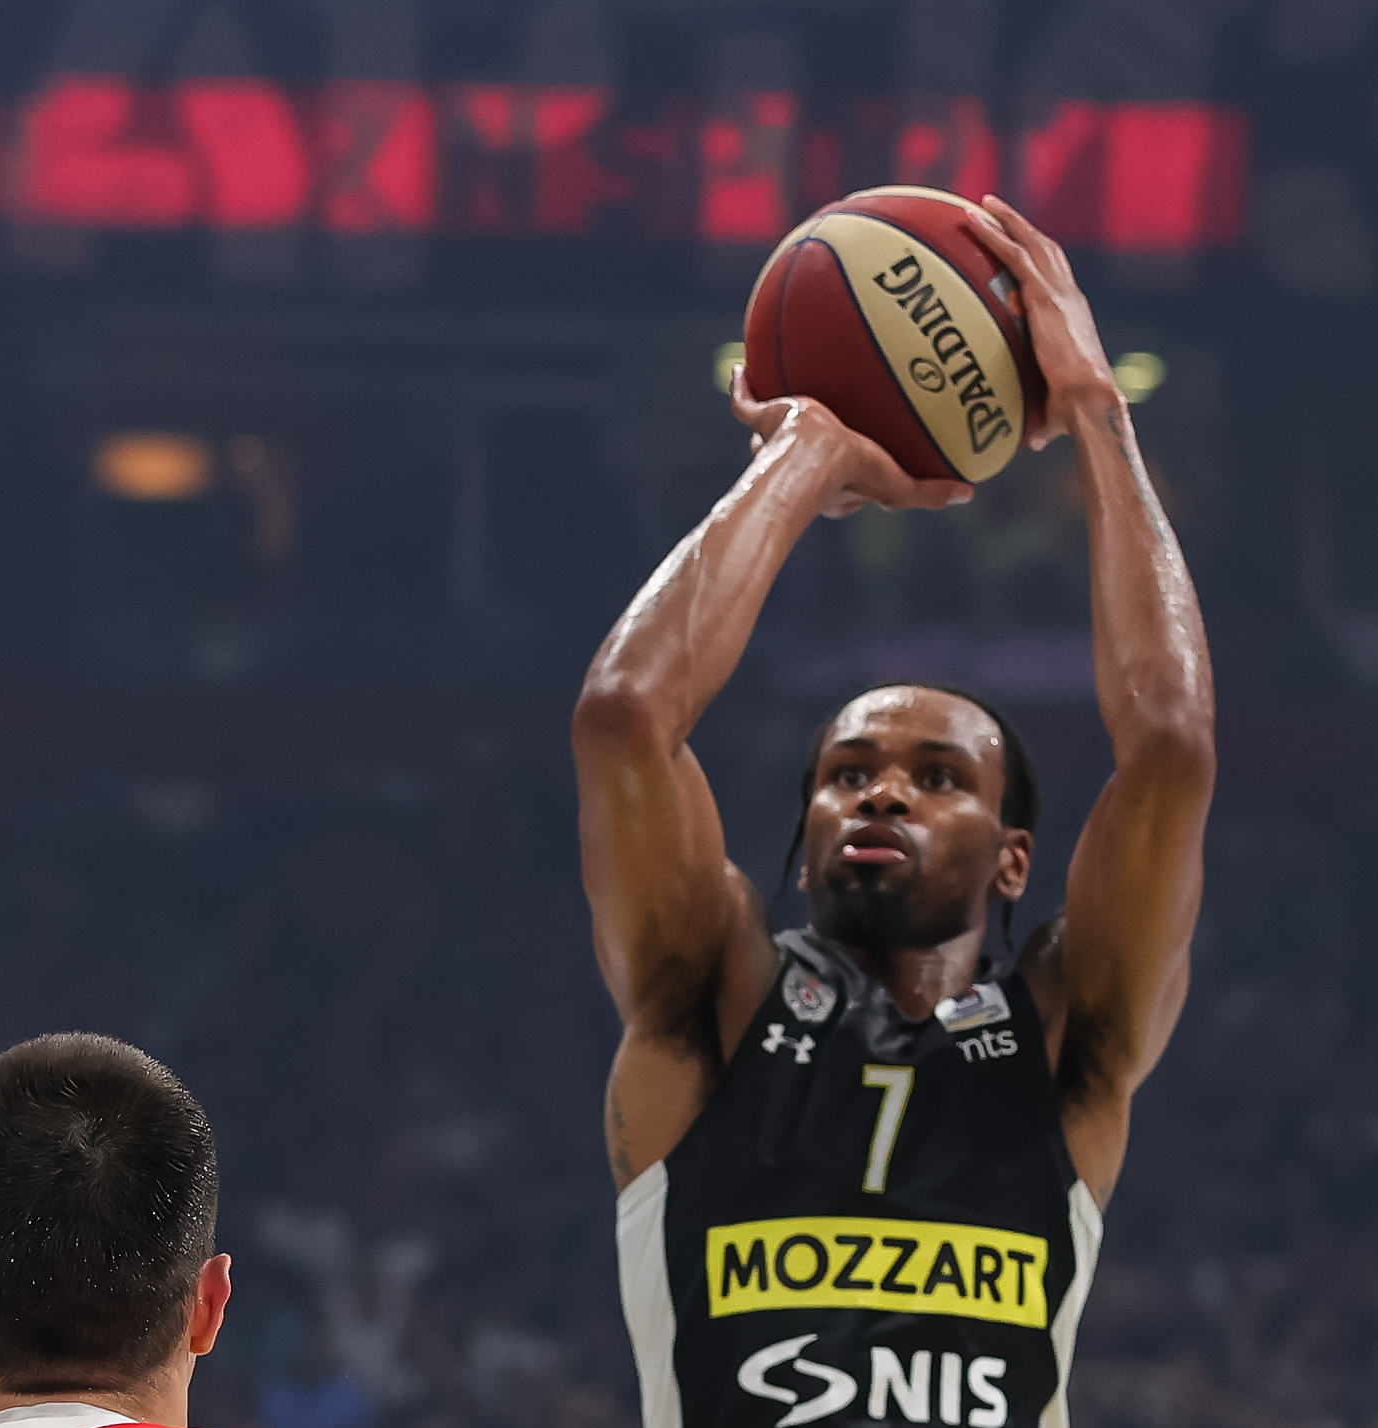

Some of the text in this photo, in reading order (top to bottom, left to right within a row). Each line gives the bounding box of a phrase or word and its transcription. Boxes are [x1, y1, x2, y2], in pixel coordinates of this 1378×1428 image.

[873, 253, 1013, 454] SPALDING
[862, 1063, 915, 1194] 7
[721, 1234, 1035, 1307] MOZZART
